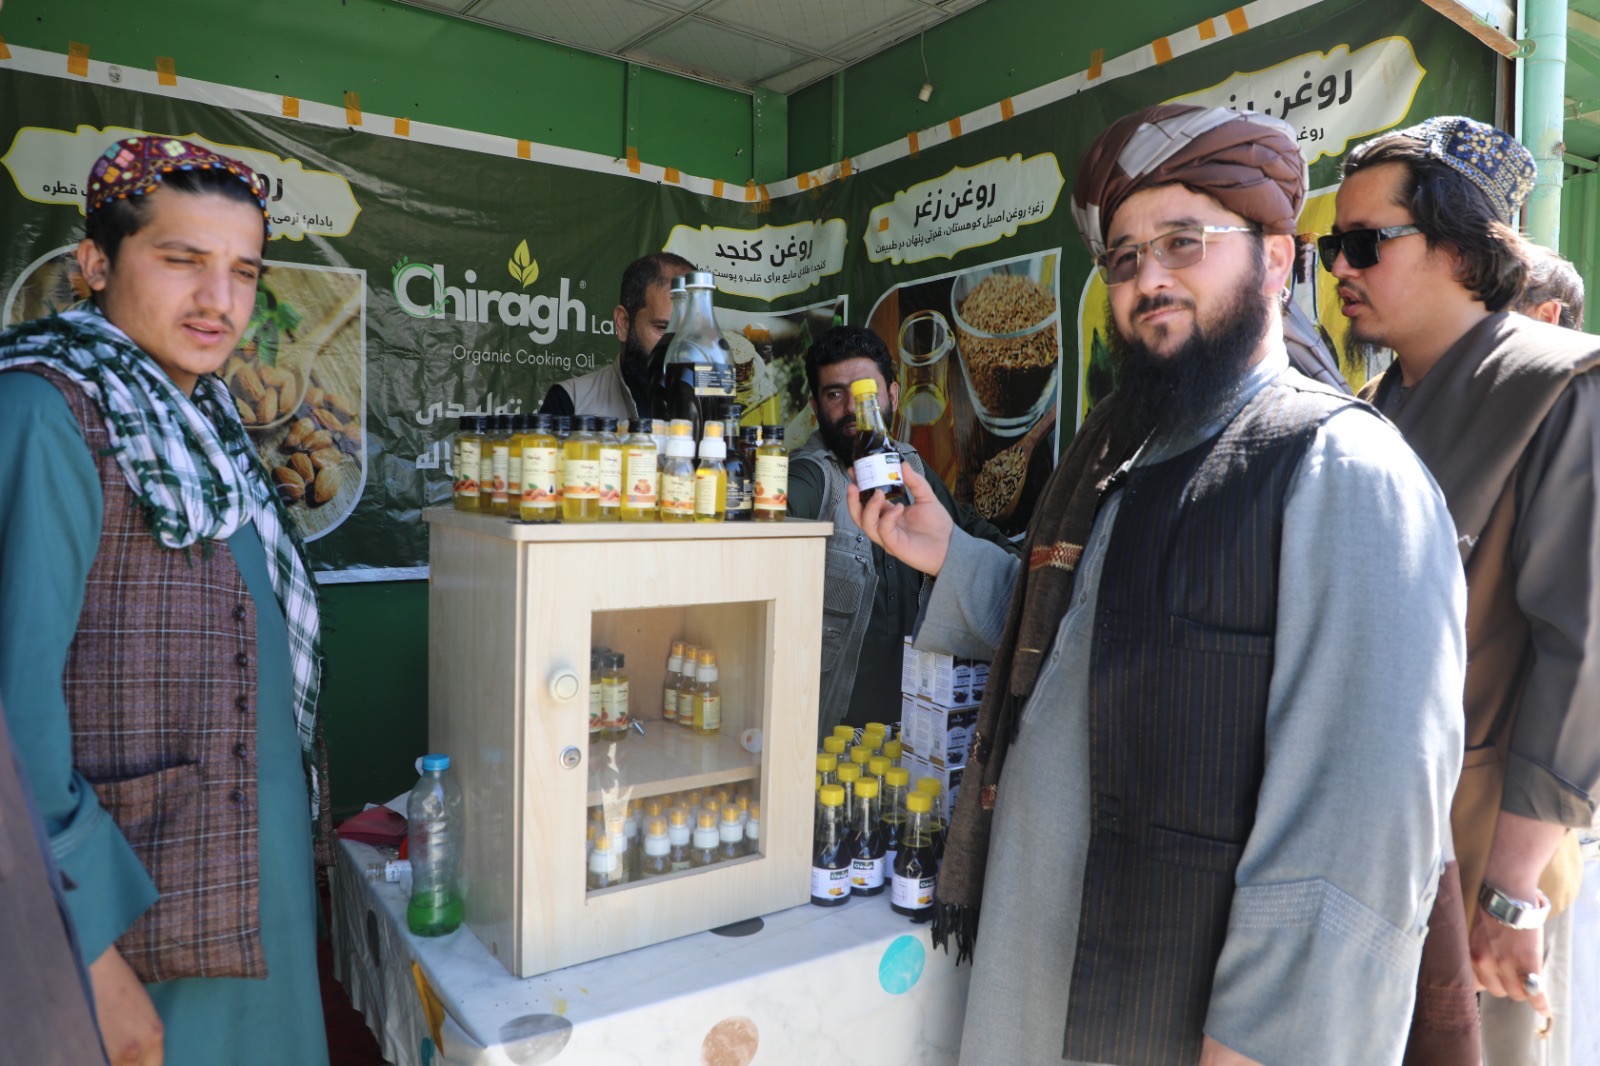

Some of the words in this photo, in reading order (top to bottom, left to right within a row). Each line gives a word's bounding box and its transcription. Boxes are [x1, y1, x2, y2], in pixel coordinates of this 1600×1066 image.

[1296, 125, 1324, 142] روغ
[914, 188, 942, 228] زغر
[944, 179, 996, 219] روغن
[982, 210, 1005, 229] اصیل
[1006, 208, 1026, 223] روغن
[715, 239, 763, 267] کنجد
[769, 235, 813, 267] روغن
[898, 241, 905, 249] در
[744, 273, 762, 283] قلب
[763, 272, 781, 284] برای
[393, 263, 587, 345] Chiragh
[591, 314, 618, 335] La
[452, 344, 511, 366] Organic
[515, 348, 571, 371] Cooking
[575, 352, 595, 369] Oil
